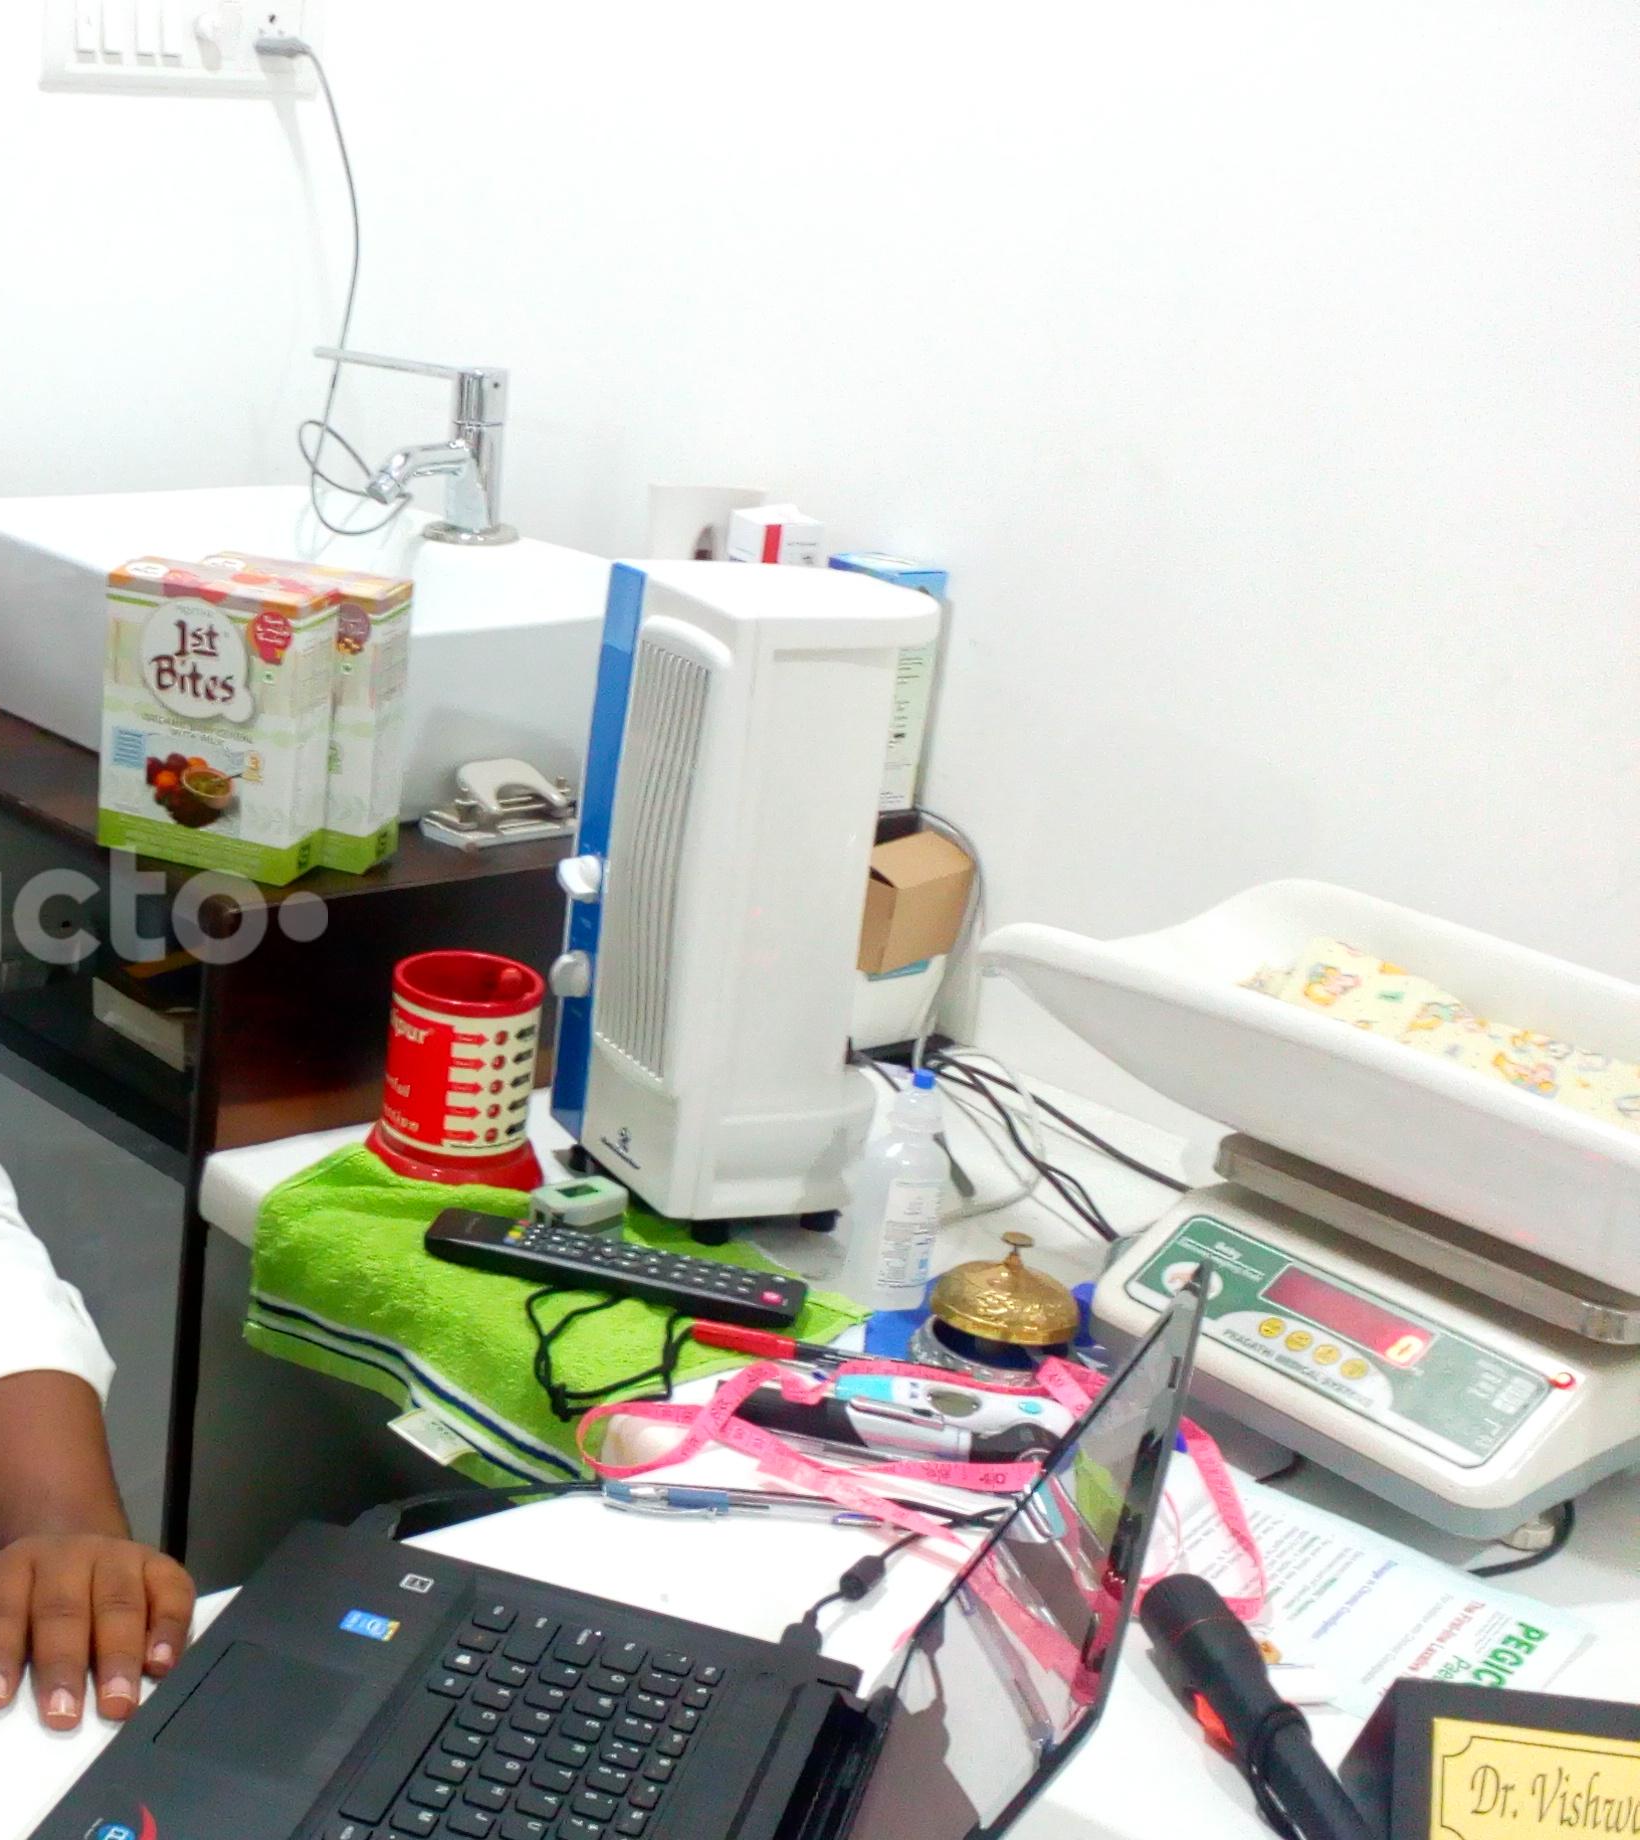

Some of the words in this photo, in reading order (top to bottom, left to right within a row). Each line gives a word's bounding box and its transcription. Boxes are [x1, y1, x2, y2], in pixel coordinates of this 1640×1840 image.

[174, 620, 219, 657] 1st
[151, 655, 235, 702] Bites
[1474, 1621, 1550, 1687] PEGIC
[1470, 1764, 1518, 1818] Dr.
